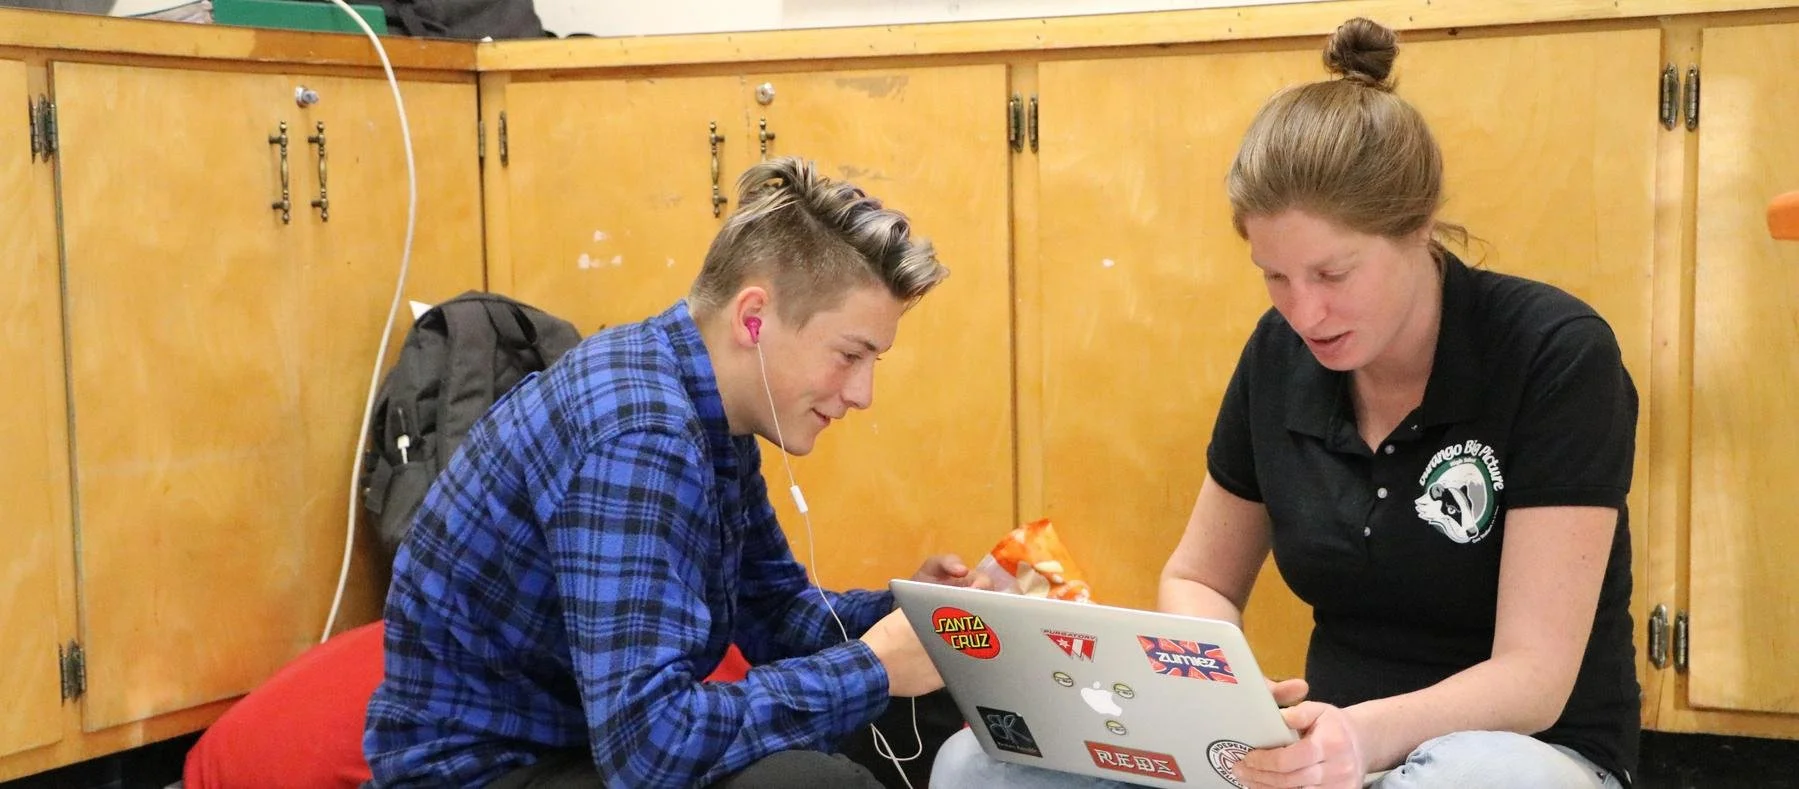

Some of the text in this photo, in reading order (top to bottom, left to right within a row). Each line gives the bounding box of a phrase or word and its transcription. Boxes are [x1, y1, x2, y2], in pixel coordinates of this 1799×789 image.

[1464, 439, 1482, 456] Big
[1478, 445, 1504, 492] Picture
[935, 616, 985, 633] SANTA
[950, 633, 990, 649] CRUZ
[1211, 742, 1254, 754] INDEPEN
